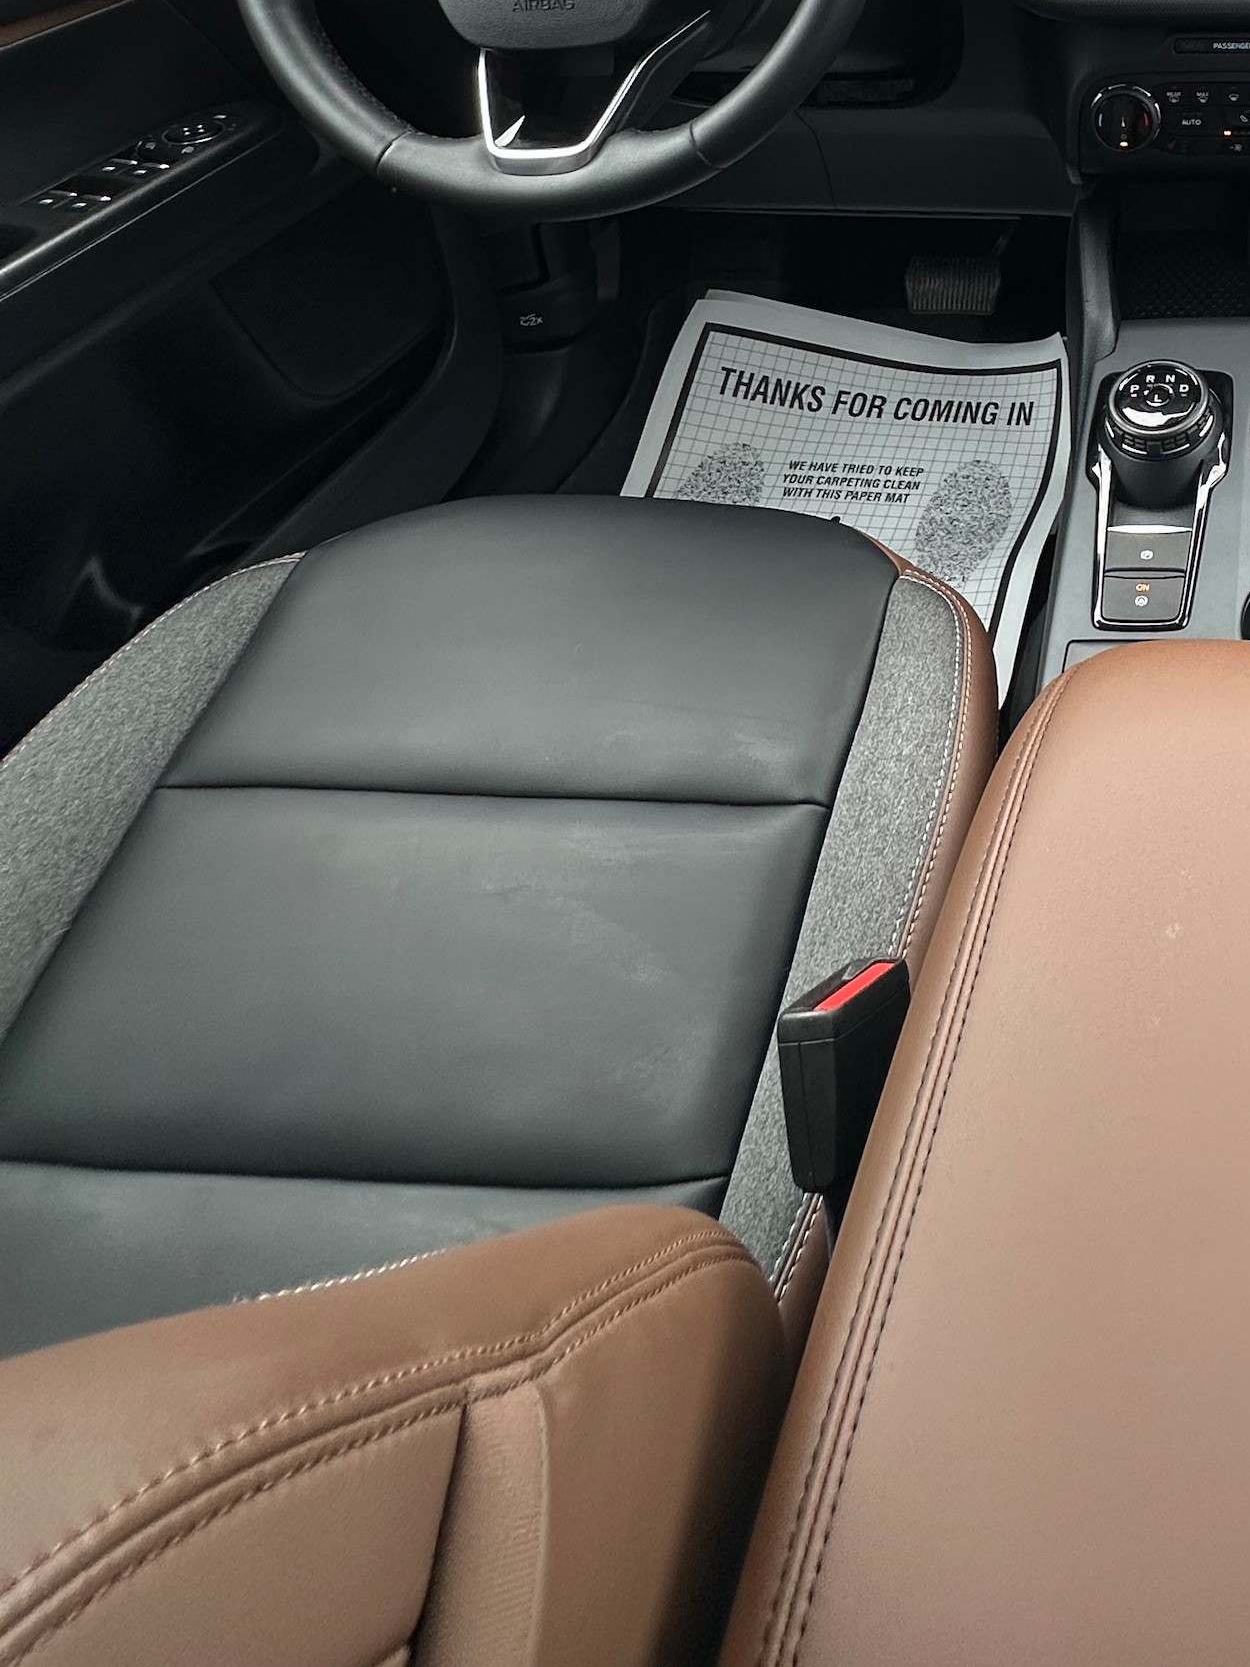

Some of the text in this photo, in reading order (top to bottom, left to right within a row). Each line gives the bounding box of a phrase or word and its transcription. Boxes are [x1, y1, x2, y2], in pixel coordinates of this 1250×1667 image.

[1146, 375, 1156, 383] R
[1165, 374, 1176, 383] N
[1130, 384, 1140, 393] P
[1179, 384, 1189, 393] D
[718, 366, 1034, 426] THANKS FOR COMING IN
[1154, 394, 1162, 403] L
[788, 460, 925, 477] WE HAVE TRIED TO KEEP
[782, 474, 921, 490] YOUR CARPETING CLEAN
[782, 487, 911, 504] WITH THIS PAPER MAT
[1135, 583, 1150, 592] ON
